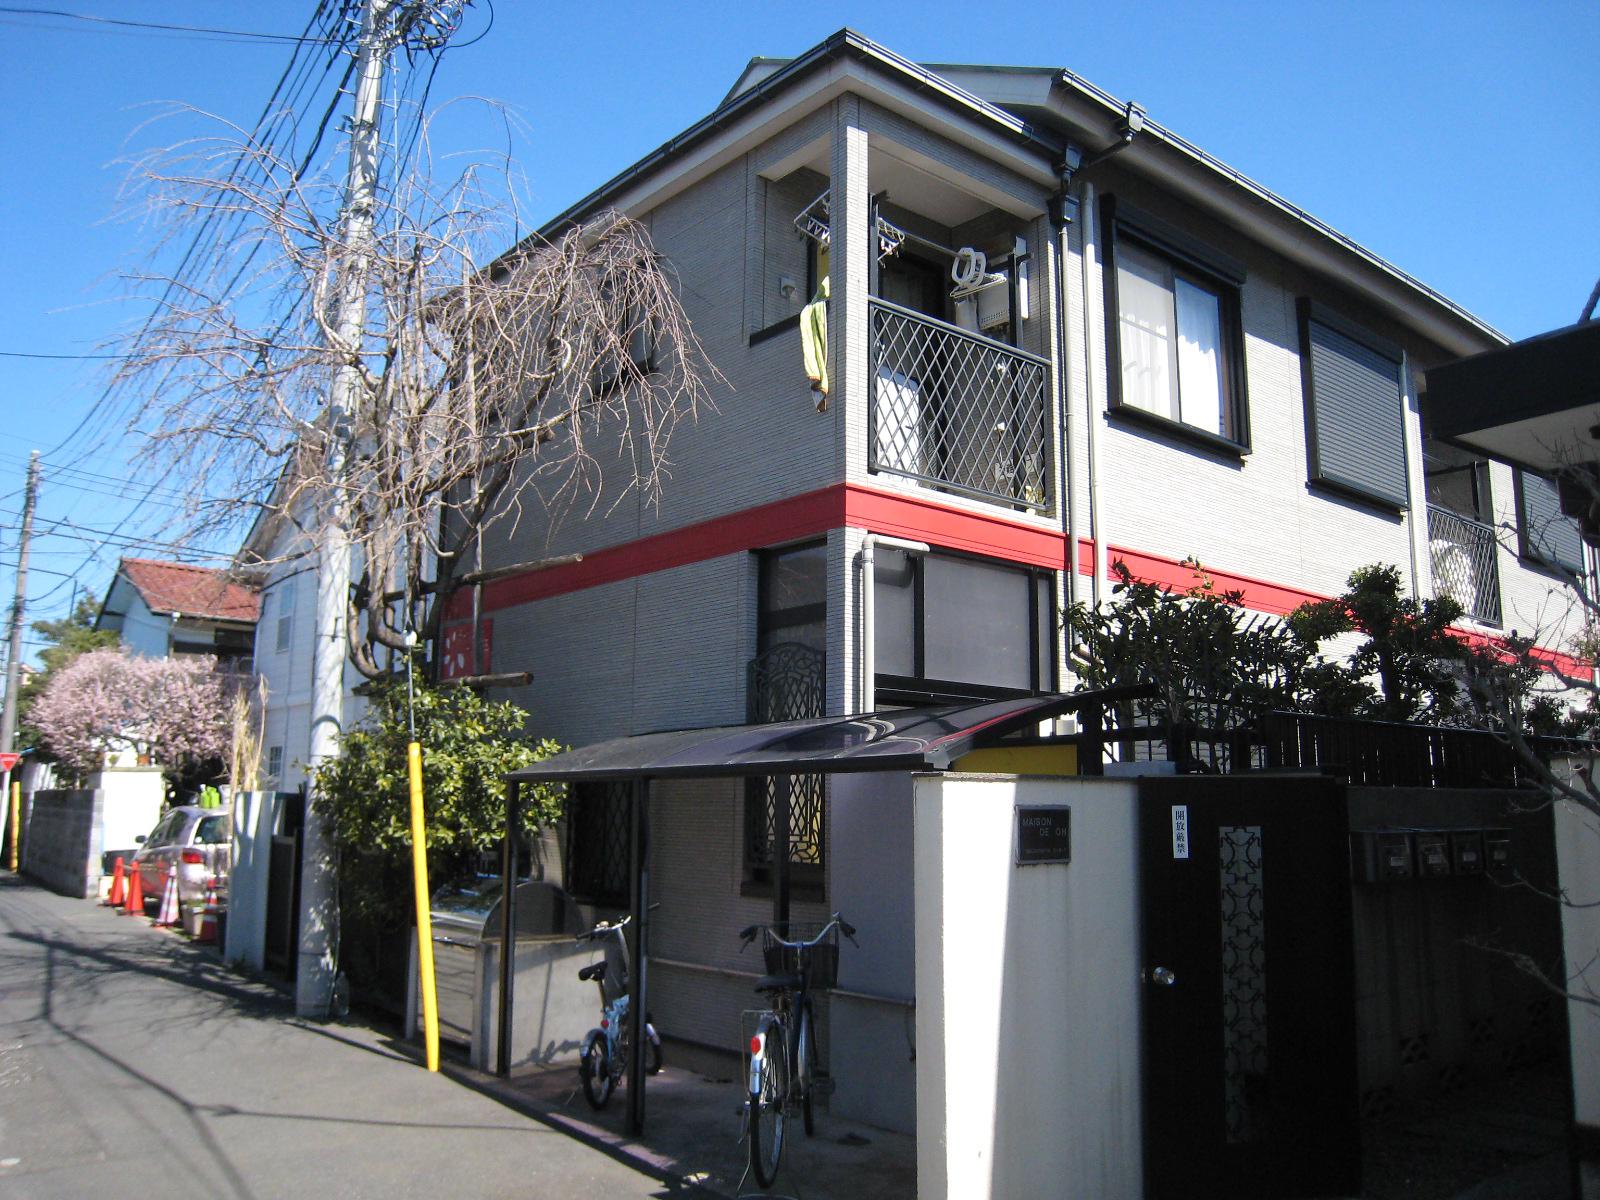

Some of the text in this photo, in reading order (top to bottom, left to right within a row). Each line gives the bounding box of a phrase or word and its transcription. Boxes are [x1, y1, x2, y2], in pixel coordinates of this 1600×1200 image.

[1022, 816, 1052, 827] MAISON
[1039, 827, 1049, 837] DE
[1175, 810, 1186, 854] 開放厳禁
